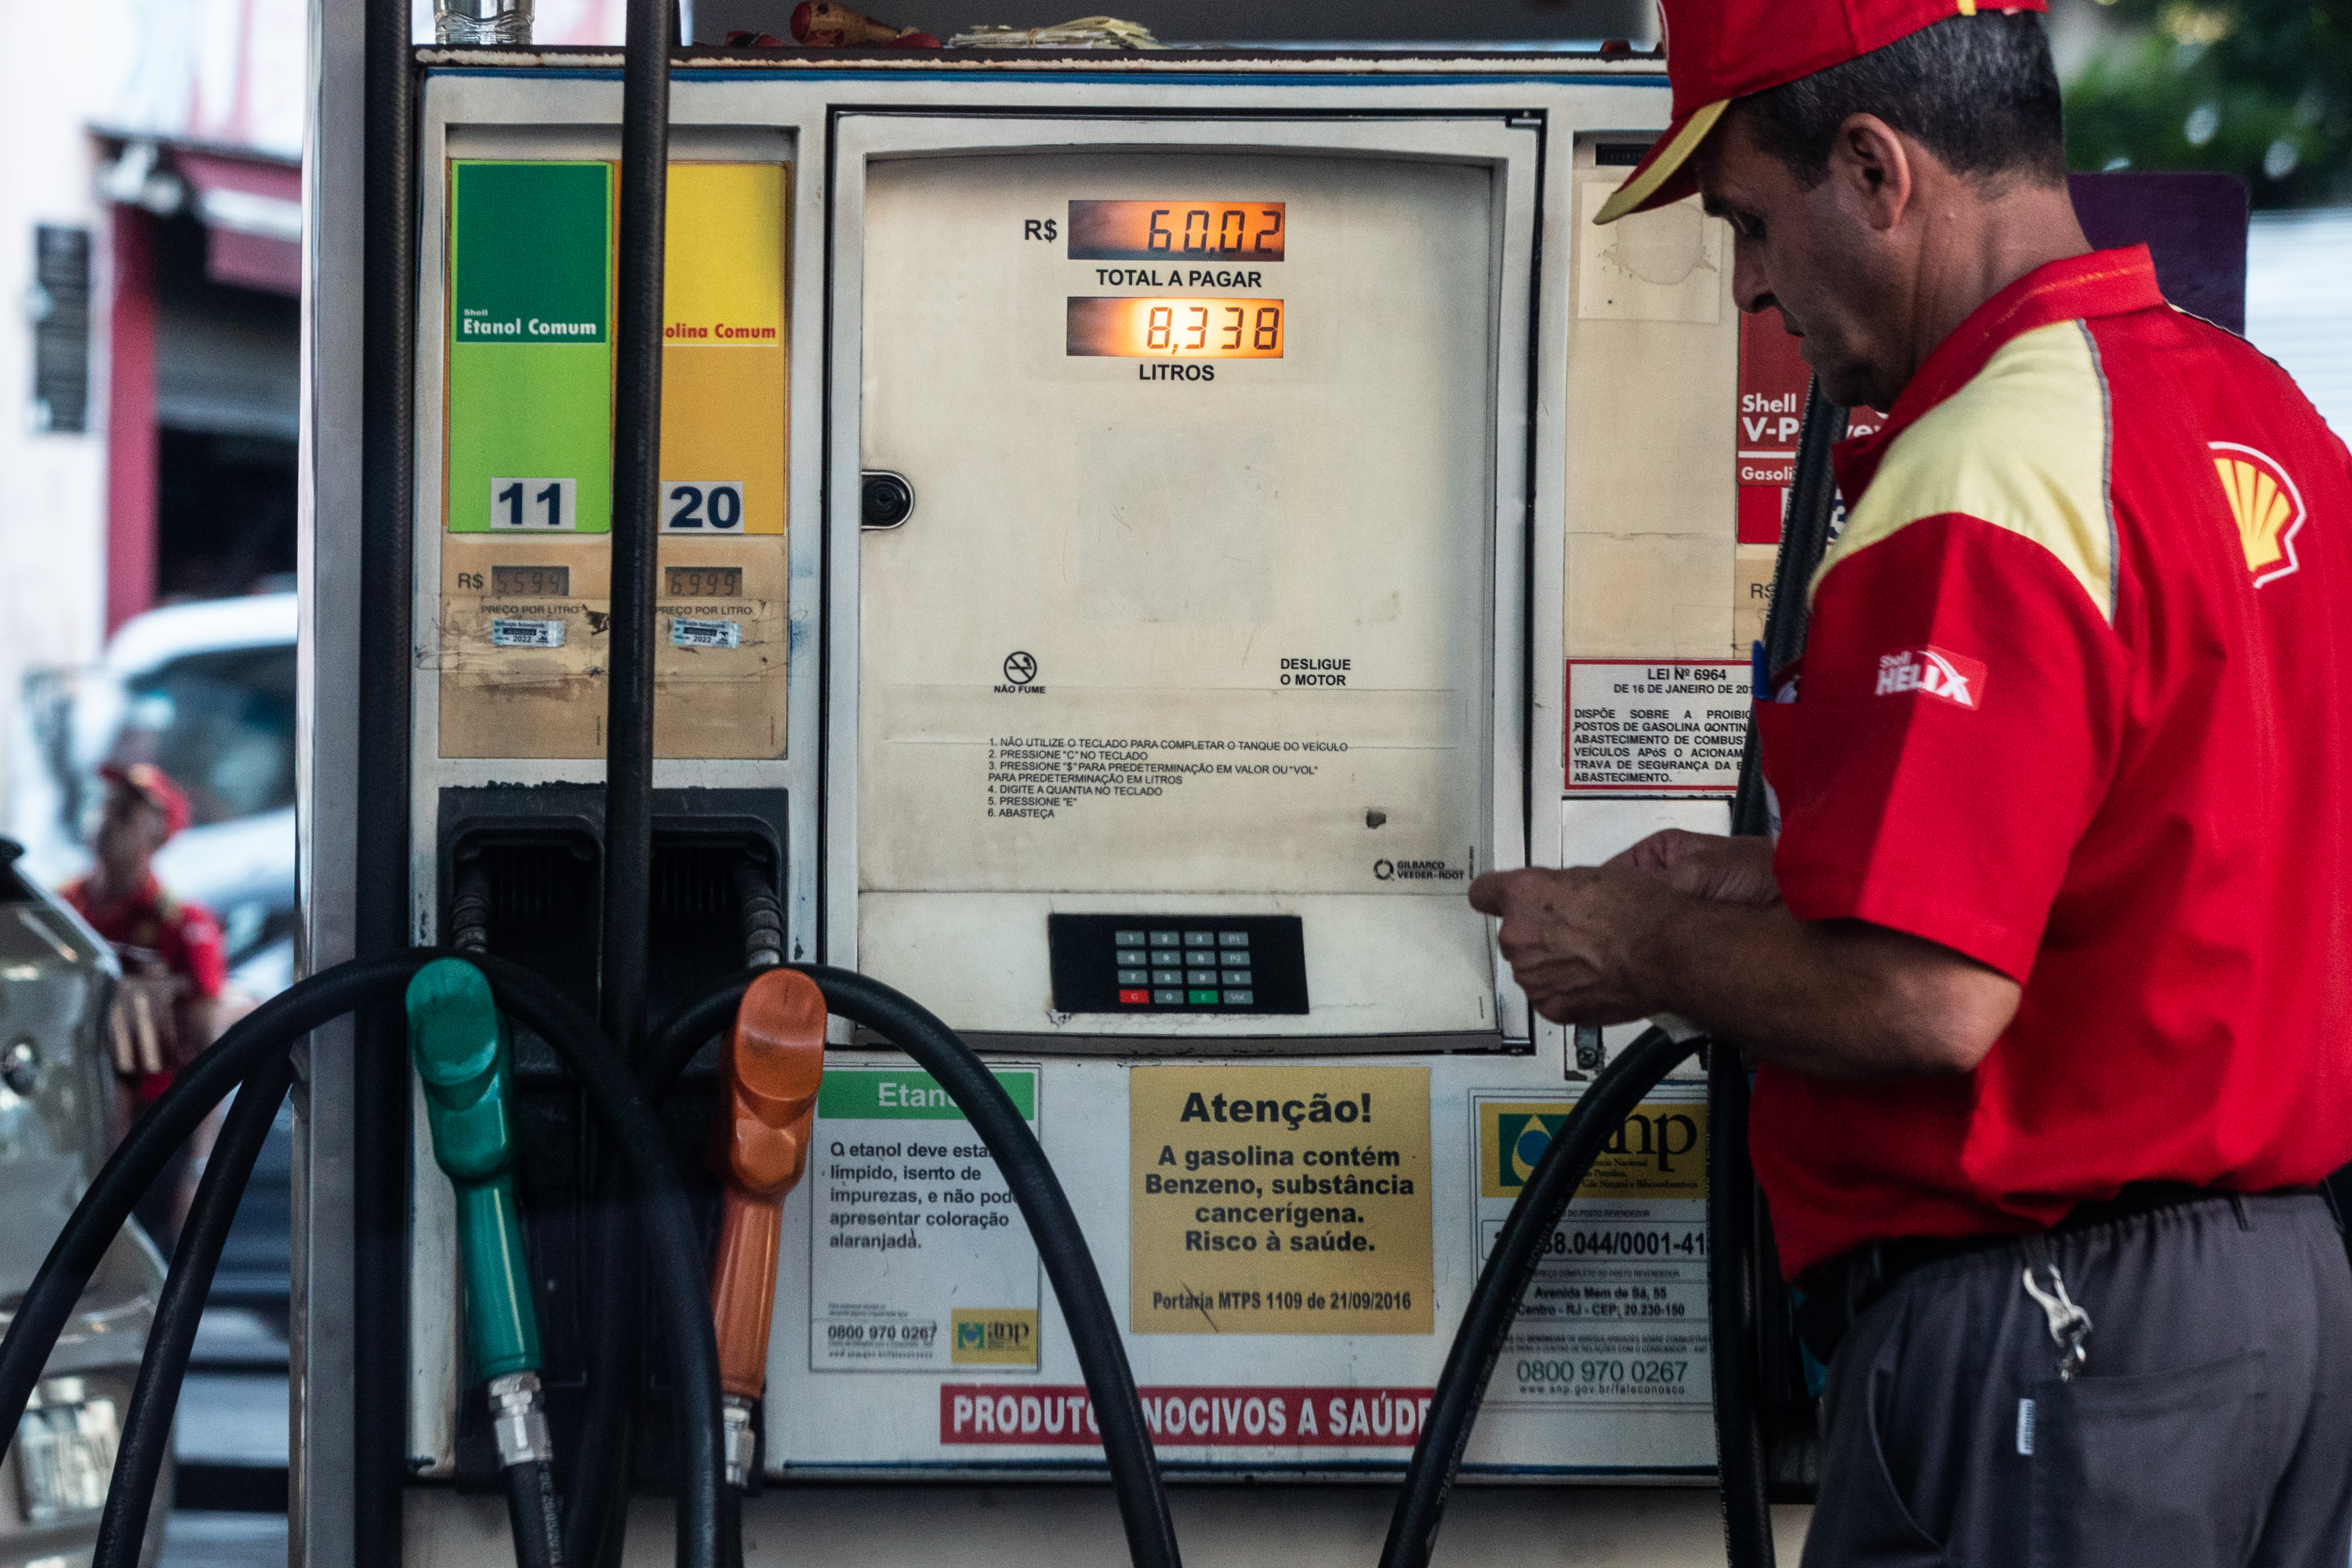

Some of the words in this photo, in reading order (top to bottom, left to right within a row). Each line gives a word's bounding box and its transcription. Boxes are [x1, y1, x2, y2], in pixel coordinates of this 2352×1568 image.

[1025, 219, 1057, 242] R$
[1096, 270, 1163, 286] TOTAL
[1168, 270, 1183, 286] A
[1189, 271, 1262, 288] PAGAR
[464, 318, 521, 335] Etanol
[528, 319, 597, 336] Comum
[662, 323, 708, 339] olina
[715, 324, 776, 339] Comum
[1139, 365, 1214, 381] LITROS
[1742, 393, 1796, 413] Shell
[1741, 466, 1793, 481] Gasoli
[499, 483, 561, 525] 11
[669, 486, 740, 528] 20
[459, 572, 484, 590] R$
[481, 605, 518, 615] PREÇO
[522, 605, 544, 614] POR
[549, 605, 579, 614] LITRO
[656, 606, 691, 616] PREÇO
[721, 607, 753, 615] LITRO
[1281, 659, 1351, 670] DESLIGUE
[1280, 674, 1291, 685] O
[1294, 674, 1346, 686] MOTOR
[1648, 669, 1670, 680] LEI
[1694, 669, 1726, 681] 6964
[1875, 657, 1973, 706] HELIX
[993, 684, 1016, 694] NÃO
[1018, 685, 1046, 694] FUME
[1614, 684, 1629, 693] DE
[1632, 684, 1644, 693] 16
[1648, 684, 1662, 693] DE
[1665, 684, 1714, 694] JANEIRO
[1718, 685, 1733, 694] DE
[1574, 708, 1615, 719] DISPÕE
[1630, 710, 1669, 719] SOBRE
[1684, 710, 1692, 719] A
[1573, 722, 1619, 731] POSTOS
[1624, 722, 1639, 731] DE
[1642, 722, 1700, 731] GASOLINA
[1704, 722, 1747, 732] CONTIN
[989, 738, 998, 746] 1.
[1000, 736, 1023, 747] NÃO
[1026, 739, 1065, 747] UTILIZE
[1068, 739, 1076, 747] O
[1079, 739, 1127, 749] TECLADO
[1131, 739, 1158, 749] PARA
[1160, 740, 1225, 750] COMPLETAR
[1227, 741, 1236, 750] O
[1239, 741, 1280, 751] TANQUE
[1283, 742, 1299, 751] DO
[1302, 741, 1348, 752] VEÍCULO
[1574, 735, 1669, 745] ABASTECIMENTO
[1675, 735, 1690, 745] DE
[989, 750, 997, 759] 2.
[1000, 750, 1061, 759] PRESSIONE
[1080, 750, 1095, 760] NO
[1099, 751, 1148, 760] TECLADO
[1574, 746, 1630, 757] VEÍCULOS
[1675, 748, 1682, 757] O
[1690, 748, 1744, 757] ACIONAM
[989, 761, 997, 771] 3.
[1000, 761, 1061, 771] PRESSIONE
[1079, 763, 1106, 771] PARA
[1109, 762, 1214, 775] PREDETERMINAÇÃO
[1217, 764, 1232, 774] EM
[1235, 765, 1269, 774] VALOR
[1272, 765, 1287, 775] OU
[1574, 760, 1611, 769] TRAVA
[1617, 760, 1632, 769] DE
[1638, 760, 1709, 771] SEGURANÇA
[1715, 760, 1731, 770] DA
[989, 773, 1016, 782] PARA
[1019, 773, 1123, 786] PREDETERMINAÇÃO
[1127, 775, 1142, 784] EM
[1145, 775, 1183, 785] LITROS
[1574, 773, 1672, 782] ABASTECIMENTO.
[988, 785, 996, 794] 4.
[1000, 785, 1034, 794] DIGITE
[1036, 786, 1044, 794] A
[1047, 786, 1093, 795] QUANTIA
[1095, 786, 1110, 795] NO
[1114, 787, 1163, 796] TECLADO
[988, 797, 996, 805] 5.
[1000, 797, 1060, 806] PRESSIONE
[988, 808, 996, 817] 6.
[999, 808, 1054, 819] ABASTEÇA
[1398, 861, 1445, 869] GILBARCO
[878, 1083, 958, 1107] Etan
[1180, 1092, 1371, 1131] Atenção!
[830, 1142, 845, 1157] O
[850, 1142, 902, 1157] etanol
[907, 1142, 947, 1157] deve
[1159, 1145, 1177, 1165] A
[1185, 1145, 1294, 1171] gasolina
[1303, 1145, 1399, 1166] contém
[830, 1164, 898, 1182] límpido,
[903, 1165, 955, 1181] isento
[960, 1165, 982, 1181] de
[1145, 1174, 1263, 1198] Benzeno,
[1272, 1174, 1414, 1196] substância
[830, 1187, 922, 1206] impurezas,
[928, 1192, 938, 1203] e
[943, 1188, 975, 1203] não
[830, 1213, 920, 1229] apresentar
[926, 1211, 1009, 1231] coloração
[1195, 1203, 1364, 1228] cancerígena.
[829, 1232, 921, 1251] alaranjada.
[1185, 1230, 1257, 1252] Risco
[1266, 1230, 1281, 1252] à
[1290, 1230, 1375, 1252] saúde.
[1152, 1292, 1214, 1310] Portaria
[1218, 1292, 1261, 1310] MTPS
[1266, 1292, 1302, 1310] 1109
[1307, 1292, 1326, 1310] de
[1330, 1292, 1411, 1310] 21/09/2016
[1535, 1287, 1581, 1299] Avenida
[1584, 1287, 1610, 1298] Mem
[1614, 1287, 1628, 1298] de
[828, 1324, 863, 1340] 0800
[869, 1324, 896, 1340] 970
[902, 1324, 937, 1341] 0267
[1517, 1360, 1573, 1383] 0800
[1581, 1360, 1624, 1382] 970
[1632, 1360, 1688, 1382] 0267
[1142, 1396, 1287, 1435] NOCIVOS
[1298, 1399, 1319, 1435] A
